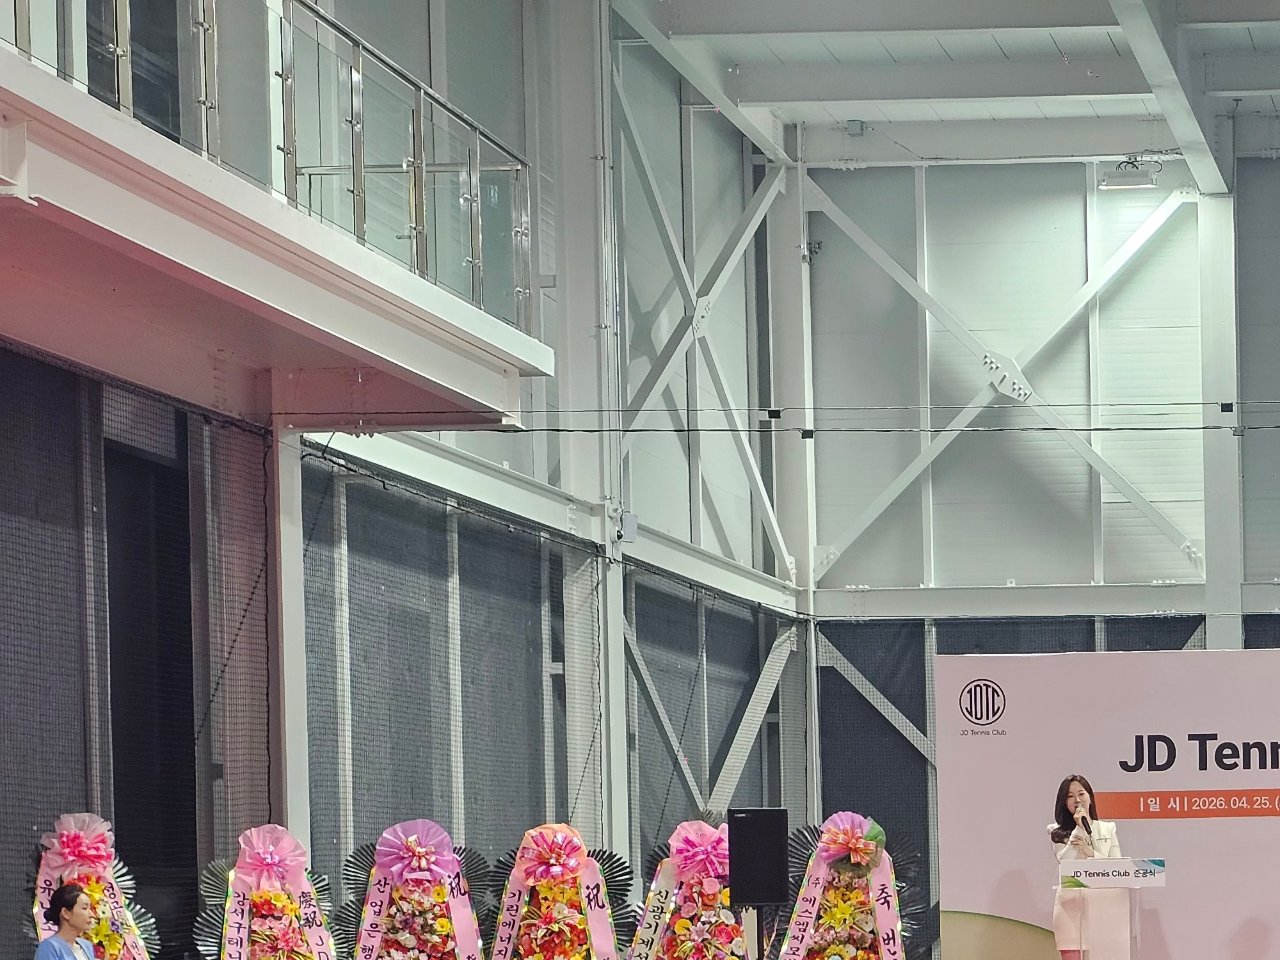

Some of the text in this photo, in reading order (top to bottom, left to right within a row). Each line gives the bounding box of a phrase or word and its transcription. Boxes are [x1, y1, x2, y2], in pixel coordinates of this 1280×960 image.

[971, 729, 990, 737] Tennis
[992, 729, 1007, 737] Club
[1118, 734, 1177, 773] JD
[1192, 797, 1228, 810] 2026.
[1230, 796, 1251, 809] 04.
[1253, 796, 1273, 809] 25.
[447, 871, 469, 899] 祝
[1073, 868, 1156, 878] JD Tennis Club 준공식
[586, 882, 606, 911] 祝
[874, 883, 893, 911] 축
[360, 876, 390, 960] 산업은행
